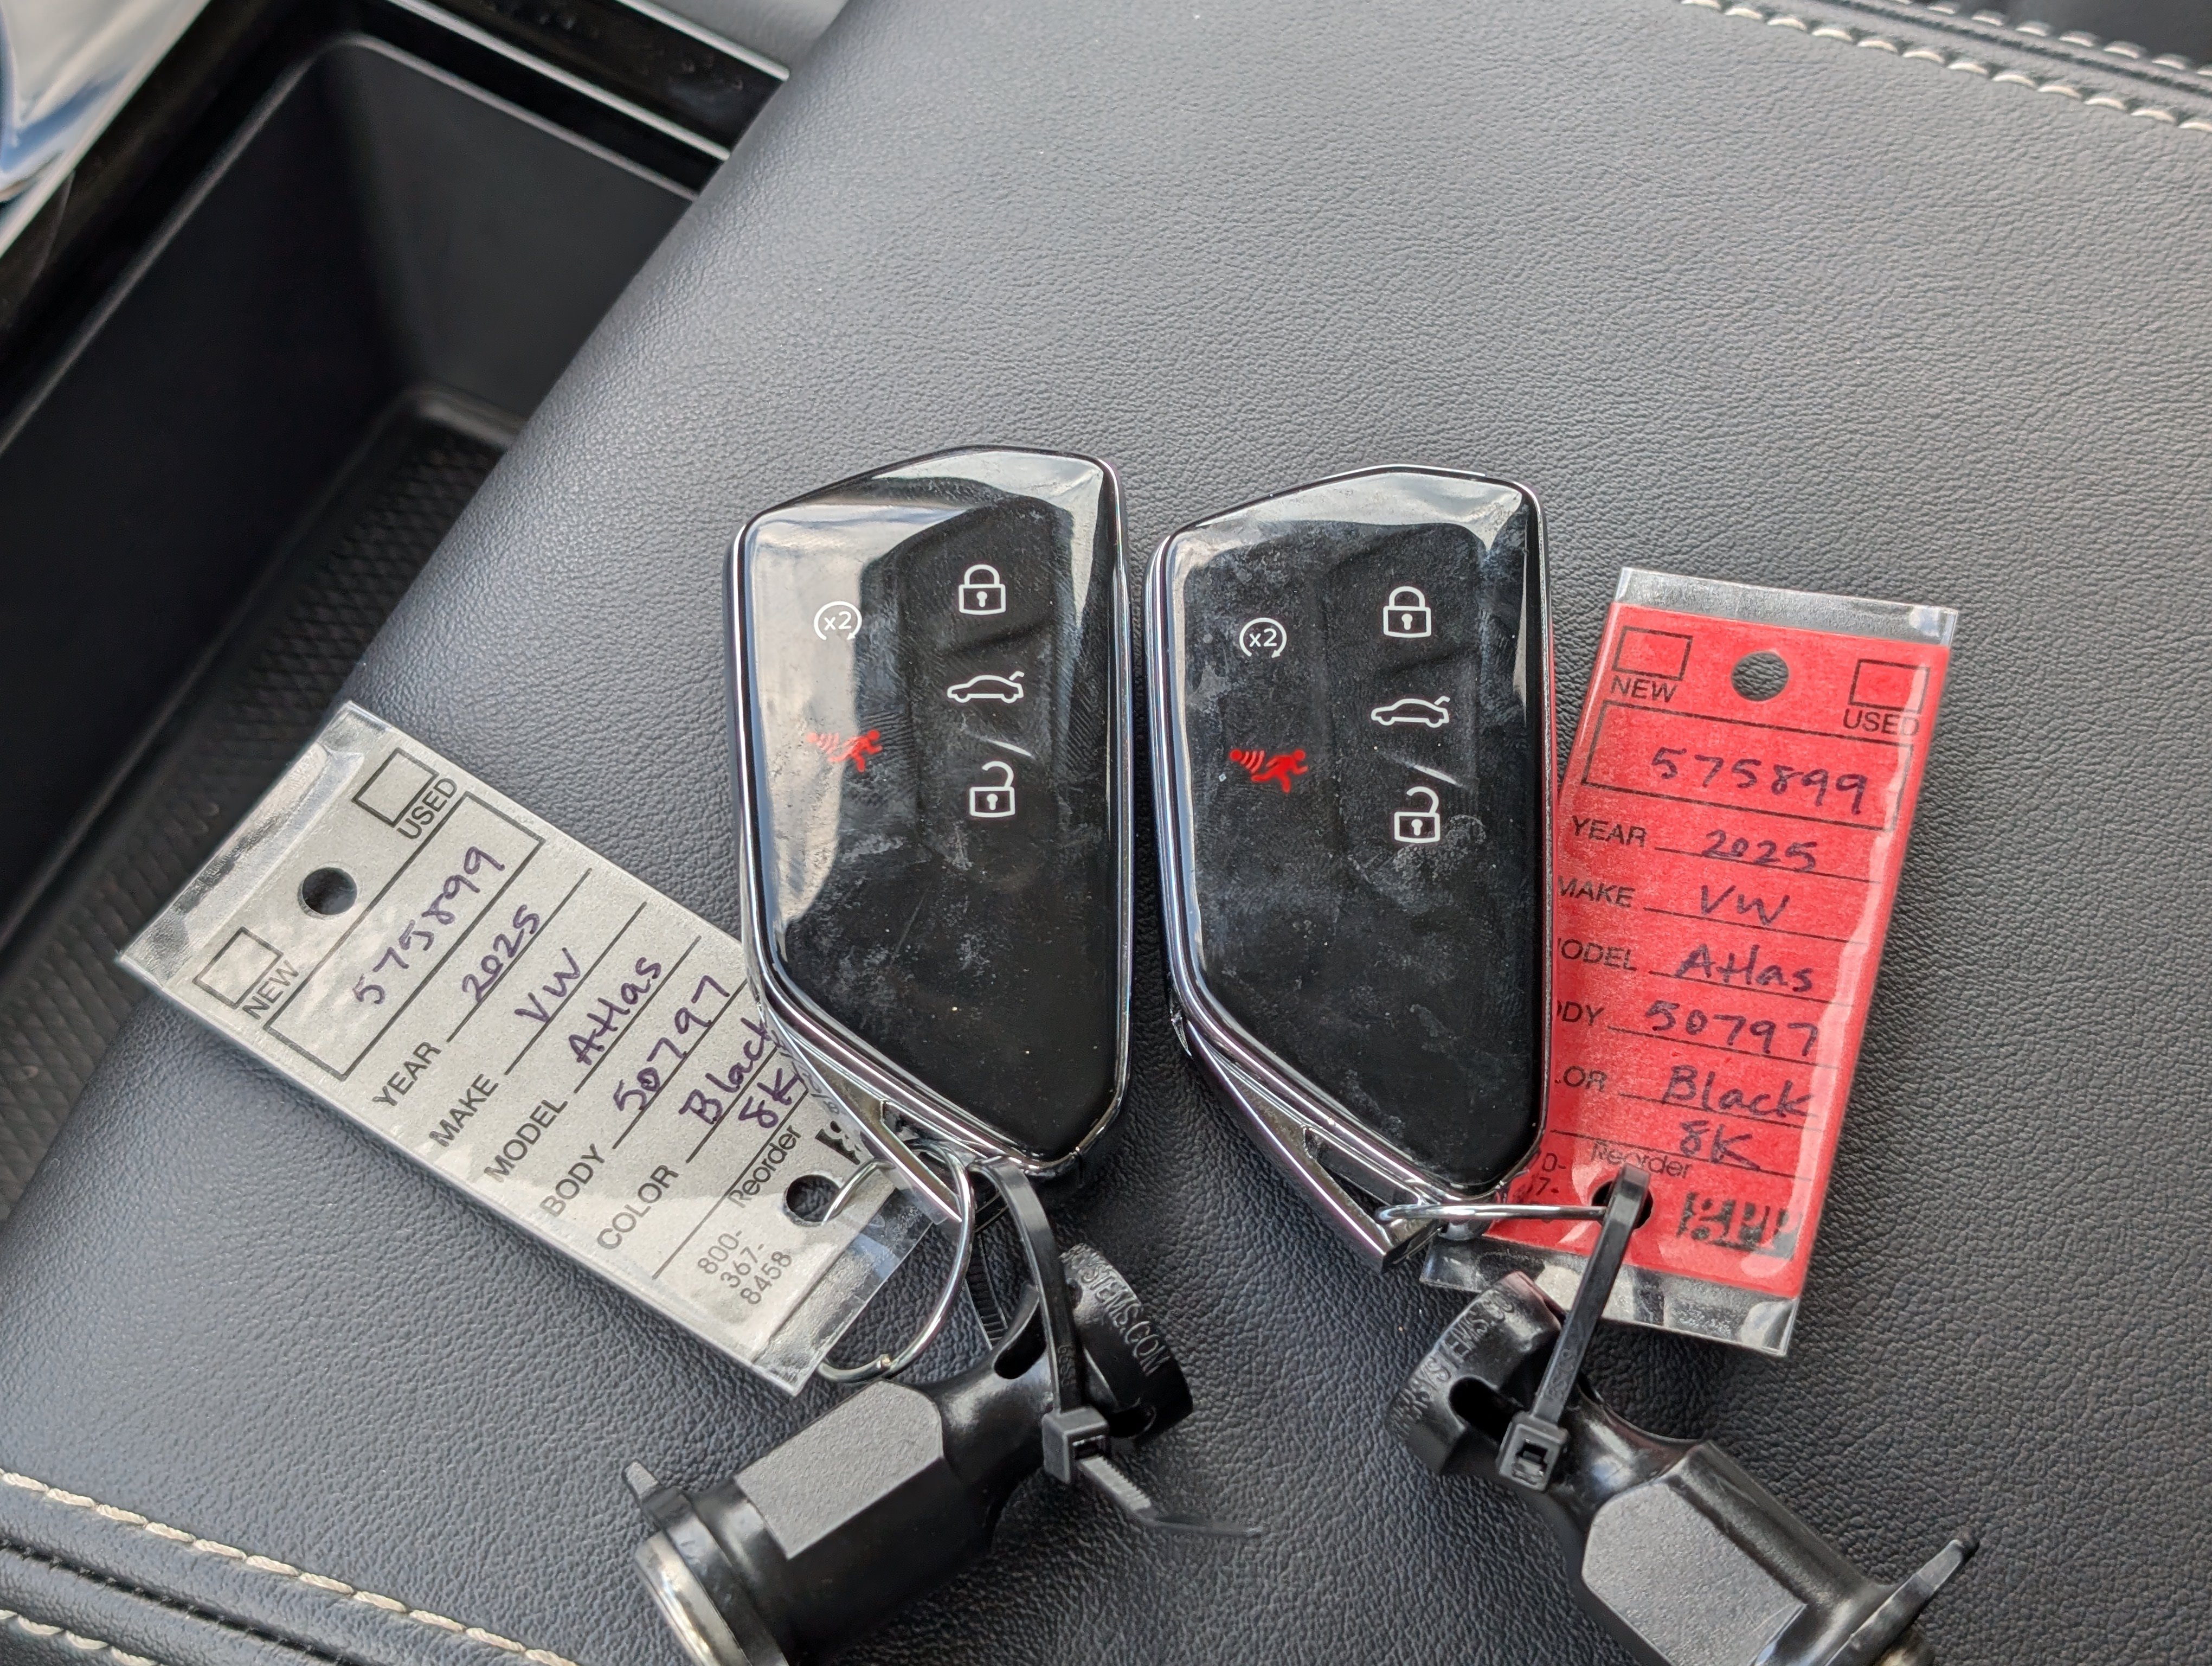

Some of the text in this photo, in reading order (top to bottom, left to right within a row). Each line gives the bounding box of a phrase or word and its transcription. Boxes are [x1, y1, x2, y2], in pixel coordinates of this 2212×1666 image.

[824, 611, 852, 630] x2
[1249, 629, 1277, 647] x2
[1610, 678, 1676, 703] NEW
[1843, 708, 1920, 736] USED
[396, 777, 458, 840] USED
[1651, 747, 1868, 815] 575899
[1571, 816, 1647, 847] YEAR
[1701, 830, 1817, 872] 2025
[353, 846, 506, 1004] 575899
[462, 904, 540, 1002] 2025
[1557, 938, 1638, 971] ODEL
[1674, 943, 1814, 992] Atlas
[244, 961, 299, 1019] NEW
[569, 957, 661, 1066] Atlas
[1557, 999, 1605, 1026] DY
[614, 975, 730, 1112] 50797
[1644, 1000, 1819, 1057] 50797
[372, 1041, 441, 1107] YEAR
[738, 1068, 800, 1129] 8K
[1662, 1065, 1819, 1119] Black
[429, 1074, 498, 1148] MAKE
[484, 1100, 568, 1182] MODEL
[729, 1125, 802, 1207] Reorder
[1591, 1140, 1693, 1178] Reorder
[1679, 1119, 1760, 1171] 8K
[541, 1144, 606, 1217] BODY
[596, 1164, 679, 1250] COLOR
[698, 1230, 742, 1274] 800-
[721, 1244, 764, 1288] 367-
[741, 1251, 792, 1304] 8458
